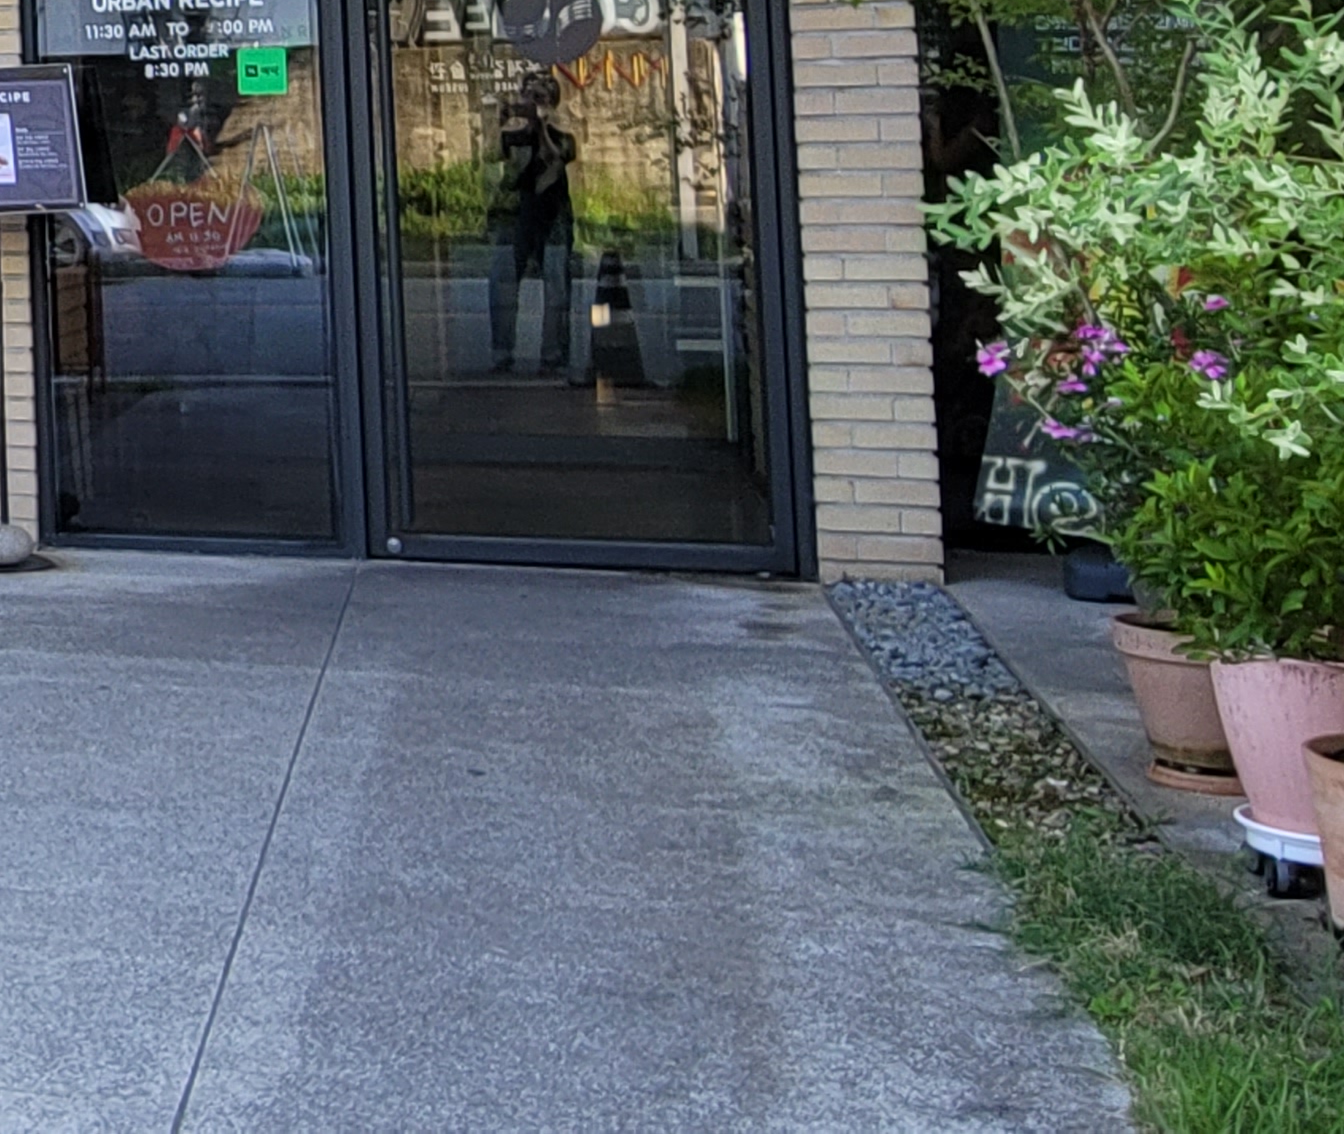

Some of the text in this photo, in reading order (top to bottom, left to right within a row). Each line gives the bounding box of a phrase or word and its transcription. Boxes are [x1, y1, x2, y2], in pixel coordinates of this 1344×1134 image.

[85, 23, 123, 40] 11:30
[128, 23, 157, 39] AM
[166, 21, 189, 37] TO
[248, 18, 274, 34] PM
[129, 42, 229, 61] LAST ORDER
[183, 61, 210, 77] PM
[146, 200, 232, 228] OPEN
